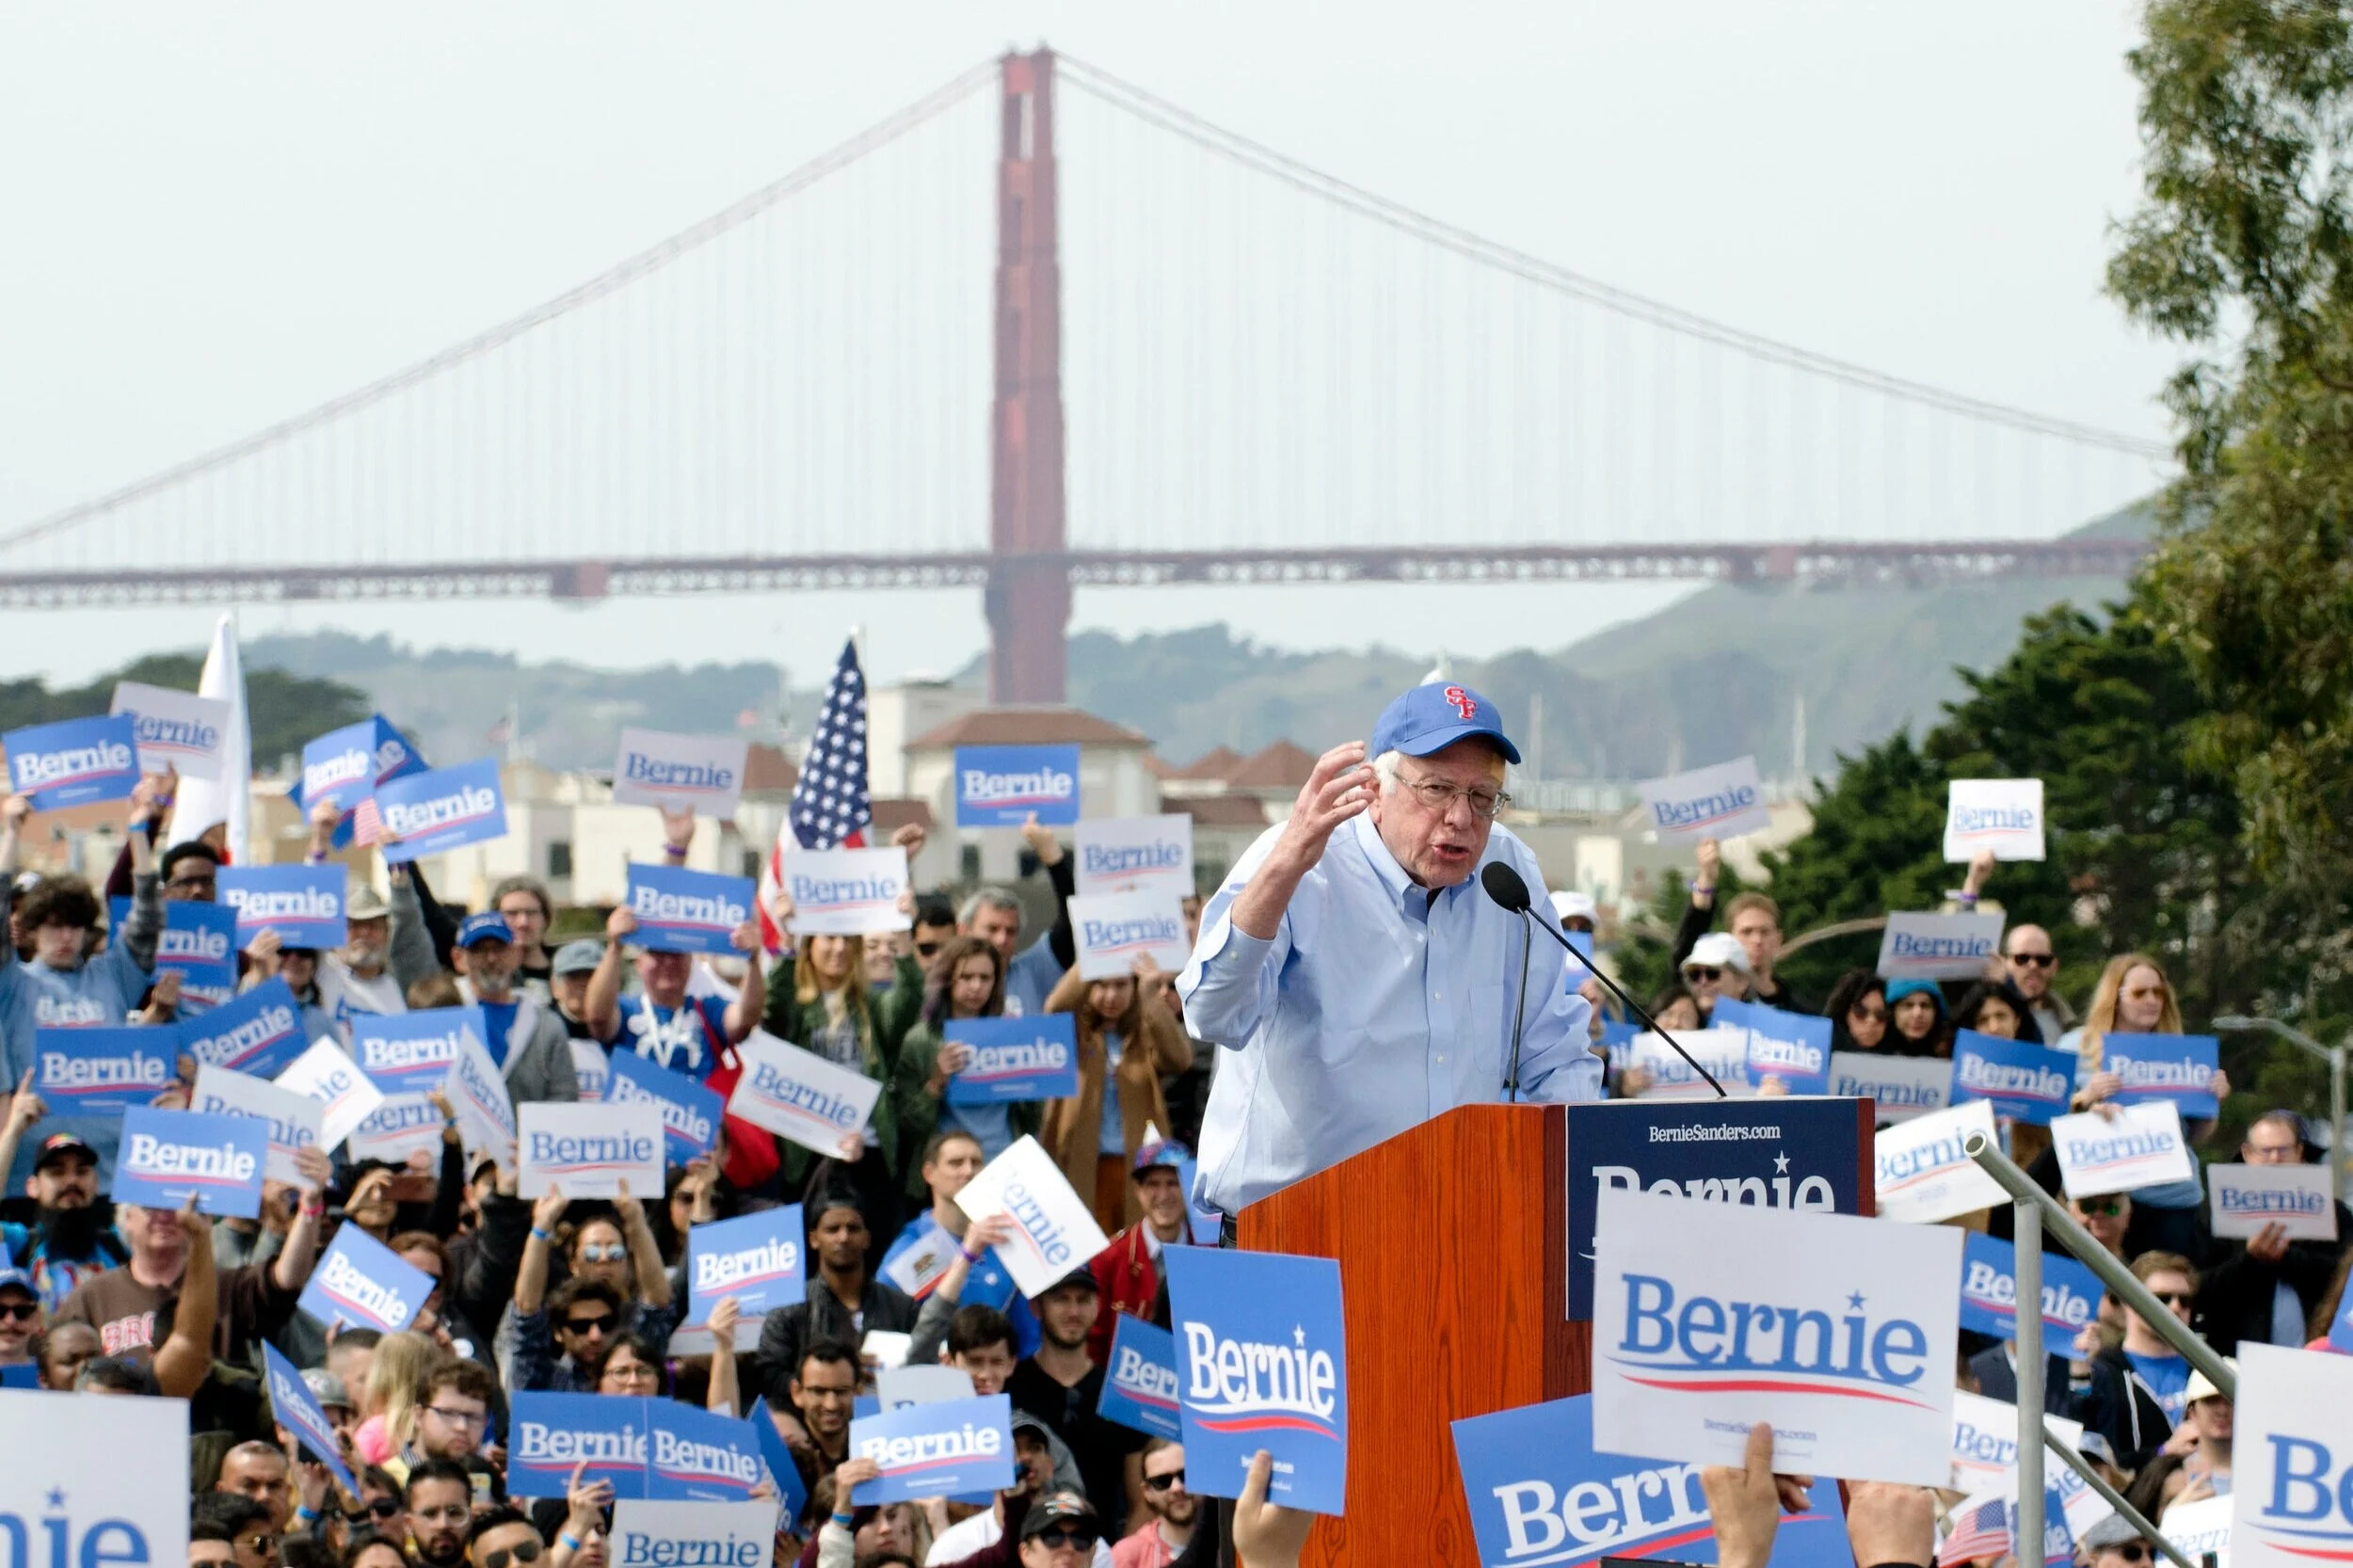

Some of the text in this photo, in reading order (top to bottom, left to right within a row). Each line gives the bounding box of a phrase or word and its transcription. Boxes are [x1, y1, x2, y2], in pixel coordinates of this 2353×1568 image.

[1444, 686, 1477, 719] SF
[124, 709, 218, 751] ernie
[16, 739, 133, 786] Bernie
[304, 747, 369, 798] Bernie
[625, 751, 733, 789] Bernie
[962, 767, 1073, 801] Bernie
[385, 785, 495, 835] Bernie
[1654, 783, 1754, 826] Bernie
[1953, 805, 2033, 832] Bernie
[1084, 838, 1182, 872] Bernie
[225, 887, 339, 918] Bernie
[634, 886, 745, 926] Bernie
[792, 874, 897, 904] Bernie
[158, 925, 229, 960] rnie
[1083, 911, 1176, 948] Bernie
[1892, 932, 1992, 957] Bernie
[191, 1003, 295, 1064] Bernie
[362, 1032, 457, 1065] Berni
[1751, 1029, 1822, 1074] Bernie
[42, 1049, 166, 1084] Bernie
[1961, 1052, 2068, 1099] Bernie
[2109, 1055, 2211, 1083] Bernie
[753, 1062, 857, 1127] Bernie
[1838, 1076, 1940, 1105] Bernie
[530, 1130, 653, 1163] Bernie
[1649, 1123, 1781, 1143] BernieSanders.com
[2067, 1128, 2174, 1165] Bernie
[129, 1133, 255, 1181] Bernie
[2220, 1186, 2325, 1215] Bernie
[1004, 1184, 1070, 1266] ernie
[696, 1236, 797, 1289] Bernie
[321, 1250, 408, 1328] Bernie
[1964, 1259, 2089, 1324] Benie
[1619, 1273, 1929, 1386] Bernie
[1183, 1321, 1336, 1418] Bernie
[653, 1430, 758, 1483] Bernie
[859, 1421, 1001, 1464] Bernie
[1493, 1464, 1713, 1559] Bern
[623, 1532, 760, 1568] Bernie
